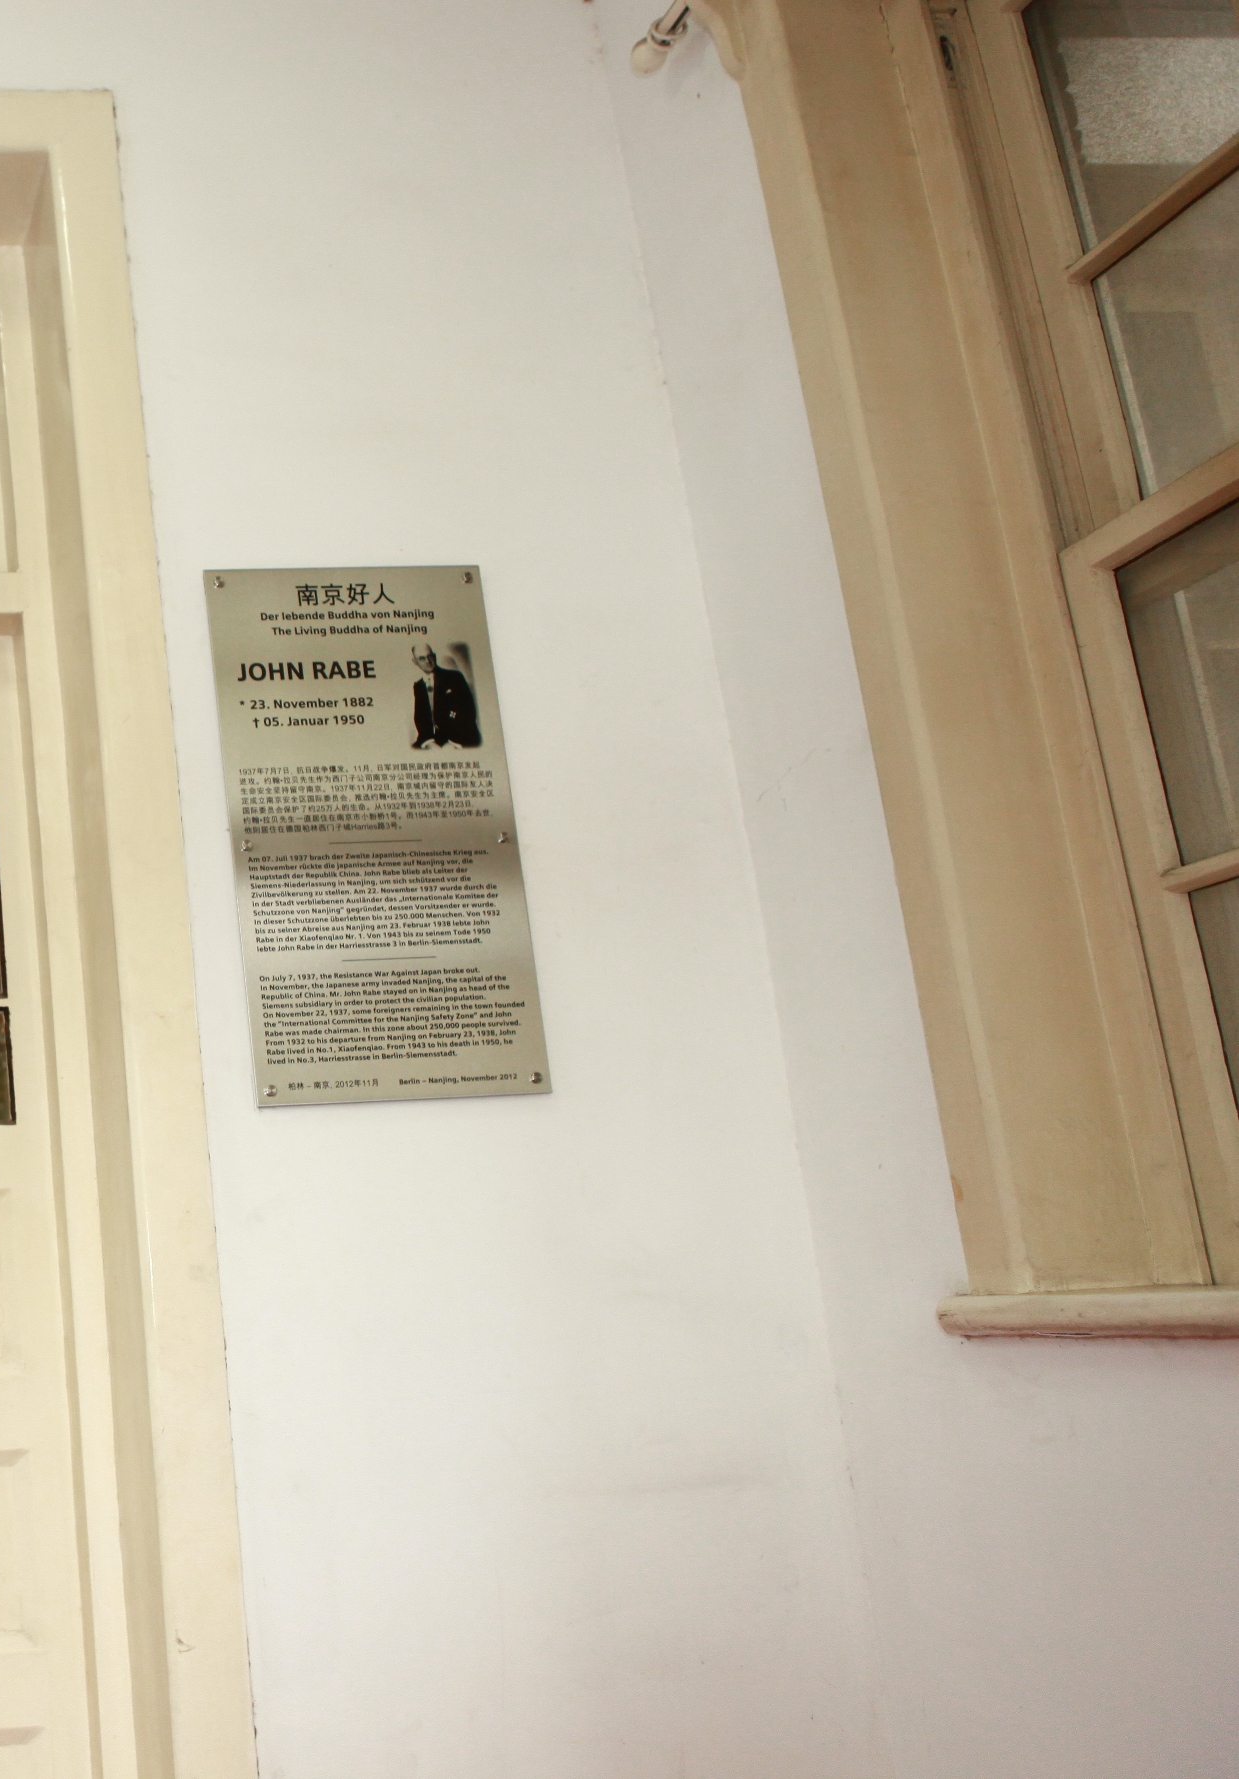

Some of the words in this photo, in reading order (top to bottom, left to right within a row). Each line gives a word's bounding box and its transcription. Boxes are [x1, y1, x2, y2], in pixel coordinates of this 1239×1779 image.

[295, 583, 395, 607] 南京好人
[260, 612, 279, 621] Der
[281, 611, 325, 620] lebende
[328, 610, 368, 620] Buddha
[371, 611, 391, 619] von
[393, 609, 435, 621] Nanjing
[271, 626, 292, 636] The
[294, 626, 327, 637] Living
[329, 625, 371, 635] Buddha
[373, 624, 384, 634] of
[386, 624, 428, 635] Nanjing
[237, 662, 304, 682] JOHN
[313, 660, 377, 680] RABE
[250, 700, 271, 710] 23.
[273, 698, 339, 709] November
[342, 697, 374, 707] 1882
[263, 717, 284, 727] 05.
[286, 716, 329, 726] Januar
[333, 715, 365, 725] 1950
[452, 849, 472, 857] Krieg
[380, 886, 418, 894] November
[270, 974, 287, 982] July
[333, 971, 373, 979] Resistance
[389, 969, 419, 978] Against
[420, 968, 442, 976] Japan
[260, 992, 293, 1001] Republic
[362, 988, 381, 996] Rabe
[382, 988, 407, 996] stayed
[428, 985, 458, 994] Nanjing
[261, 1001, 293, 1009] Siemens
[294, 1000, 333, 1009] subsidiary
[343, 998, 363, 1006] order
[374, 997, 401, 1006] protect
[274, 1010, 314, 1018] November
[372, 1006, 411, 1015] foreigners
[412, 1004, 450, 1013] remaining
[494, 1000, 525, 1008] founded
[331, 1016, 372, 1024] Committee
[399, 1014, 429, 1023] Nanjing
[430, 1013, 454, 1021] Safety
[263, 1029, 283, 1037] Rabe
[428, 1022, 460, 1031] 250,000
[460, 1020, 486, 1029] people
[328, 1035, 366, 1044] departure
[386, 1033, 416, 1042] Nanjing
[428, 1031, 462, 1040] February
[318, 1053, 370, 1062] Harriesstrasse
[460, 1074, 498, 1082] November
